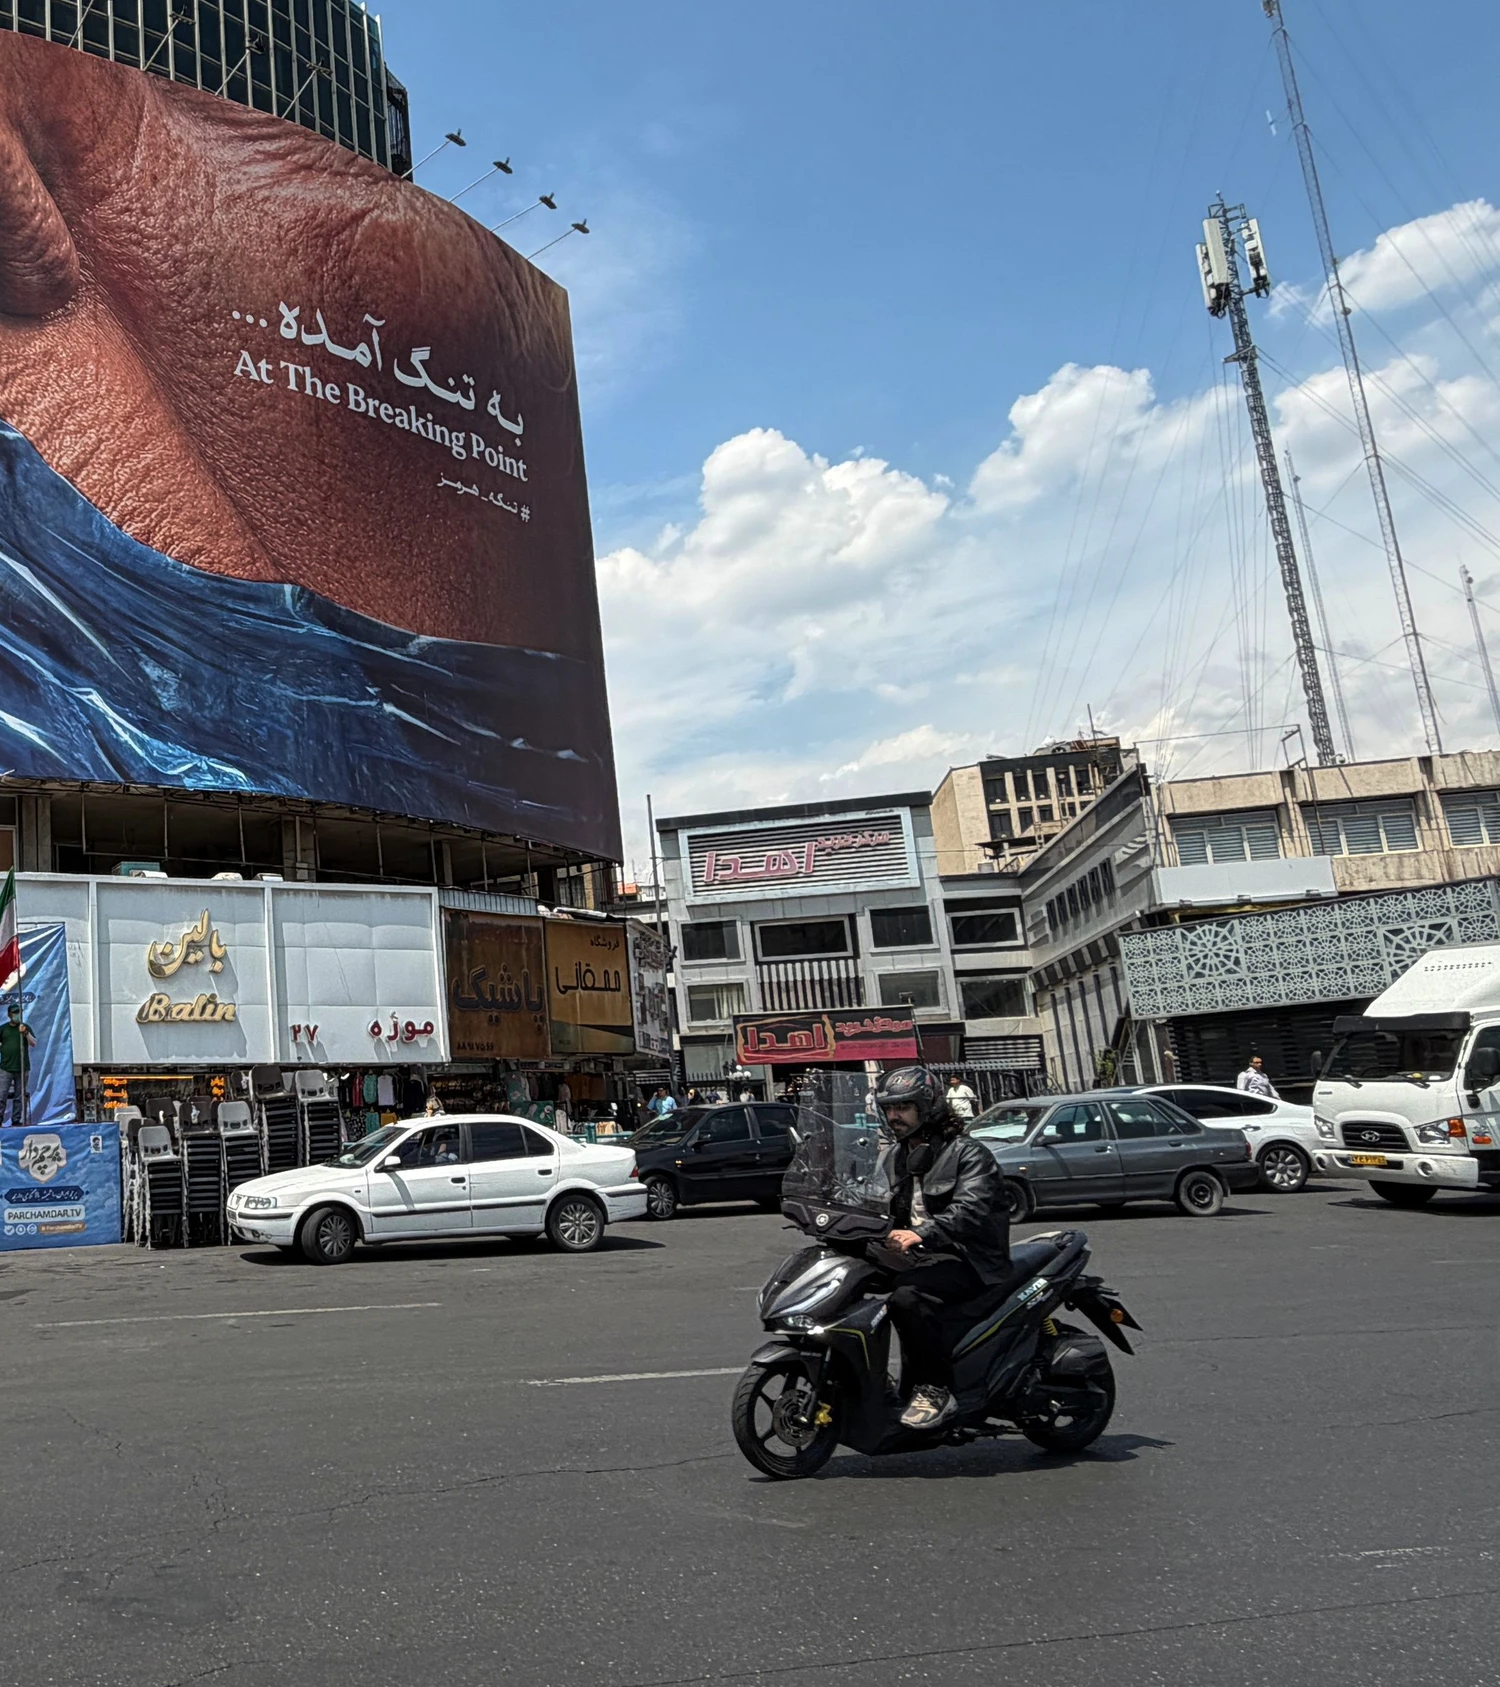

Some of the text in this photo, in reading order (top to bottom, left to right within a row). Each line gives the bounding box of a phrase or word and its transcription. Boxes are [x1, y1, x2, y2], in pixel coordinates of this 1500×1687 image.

[393, 346, 476, 410] تنگ
[233, 349, 529, 482] At The Breaking Point
[487, 389, 524, 446] به
[703, 841, 817, 883] اهدا
[147, 908, 227, 978] بالین
[590, 934, 620, 951] فروشگاه
[136, 992, 237, 1023] Balin
[289, 1023, 319, 1042] ۲۷
[746, 1023, 826, 1051] اهدا
